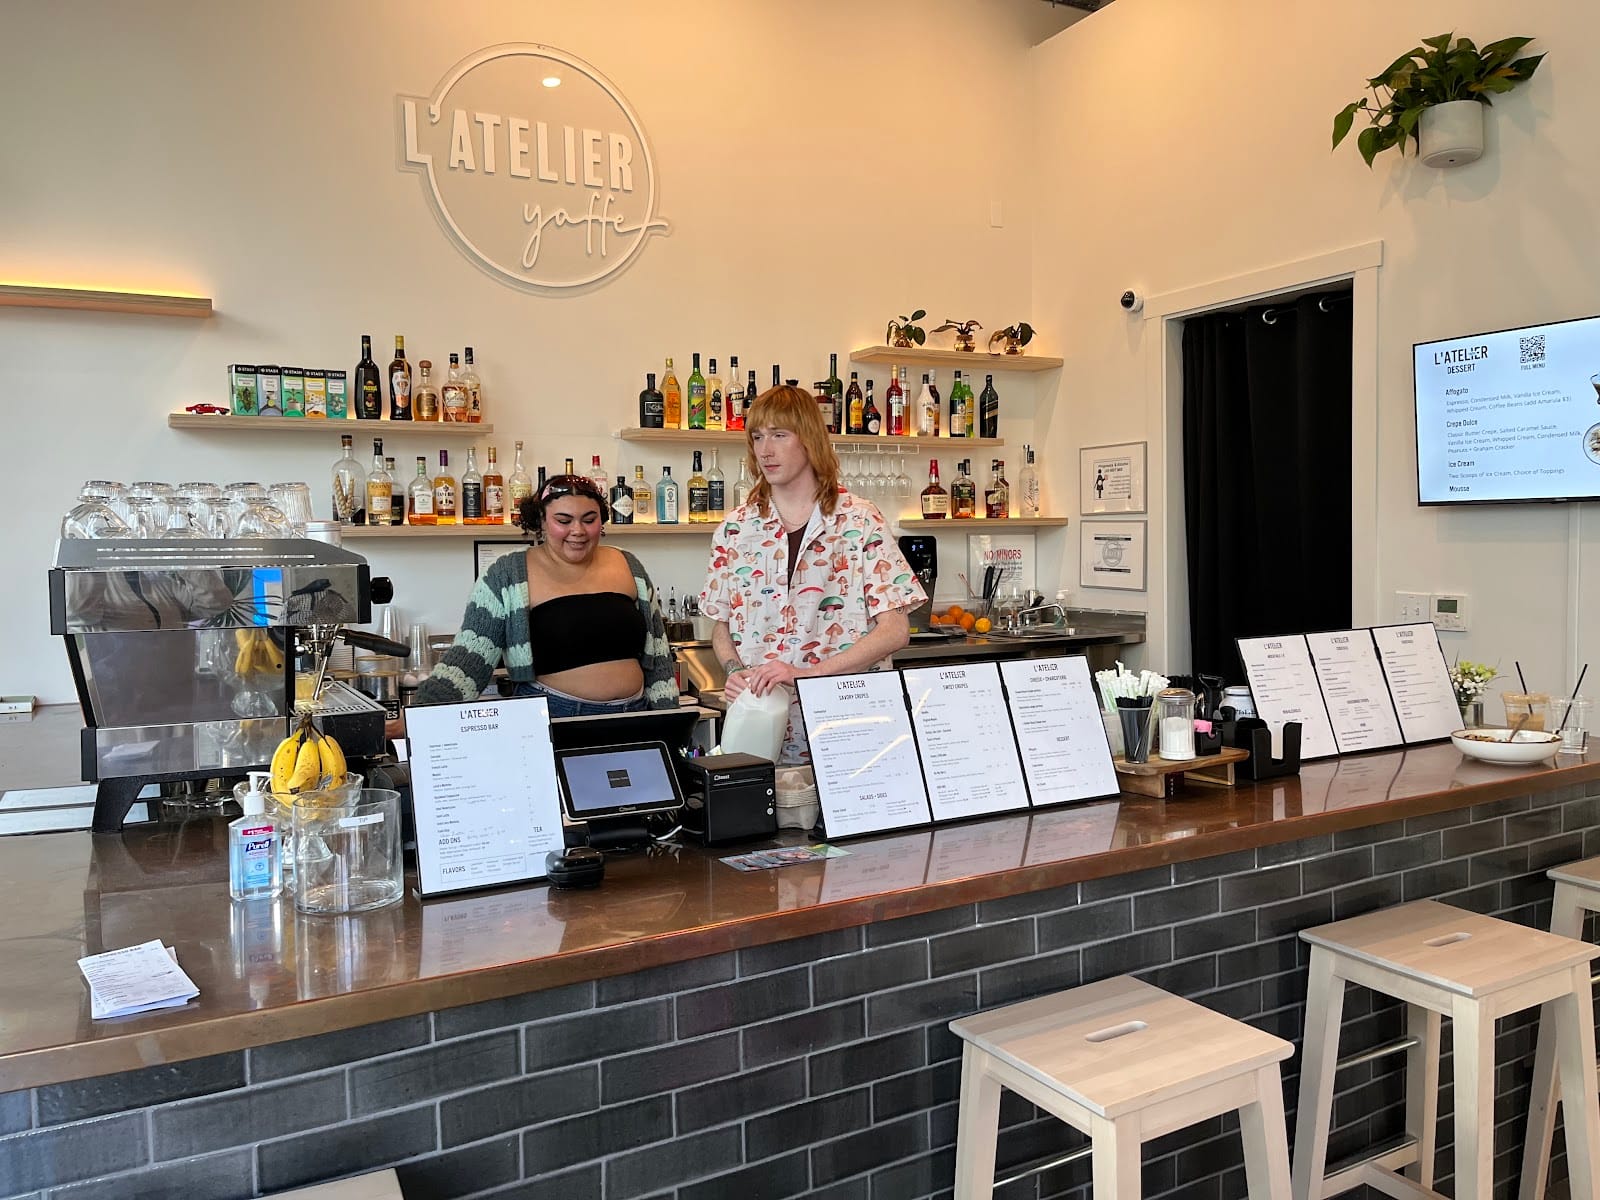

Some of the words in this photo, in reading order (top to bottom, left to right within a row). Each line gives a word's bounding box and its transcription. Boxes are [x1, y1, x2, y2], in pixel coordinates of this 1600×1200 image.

[404, 101, 633, 191] L'ATELIER
[523, 192, 668, 269] yaffe
[1434, 346, 1488, 365] L'ATELIER
[1448, 364, 1475, 374] DESSERT
[984, 550, 994, 560] NO
[996, 549, 1022, 560] MINORS
[1034, 664, 1058, 672] L'ATELIER
[940, 670, 966, 679] L'ATELIER
[837, 680, 866, 690] L'ATELIER
[460, 708, 499, 719] L'ATELIER
[248, 840, 270, 850] Purell
[442, 866, 466, 875] FLAVORS
